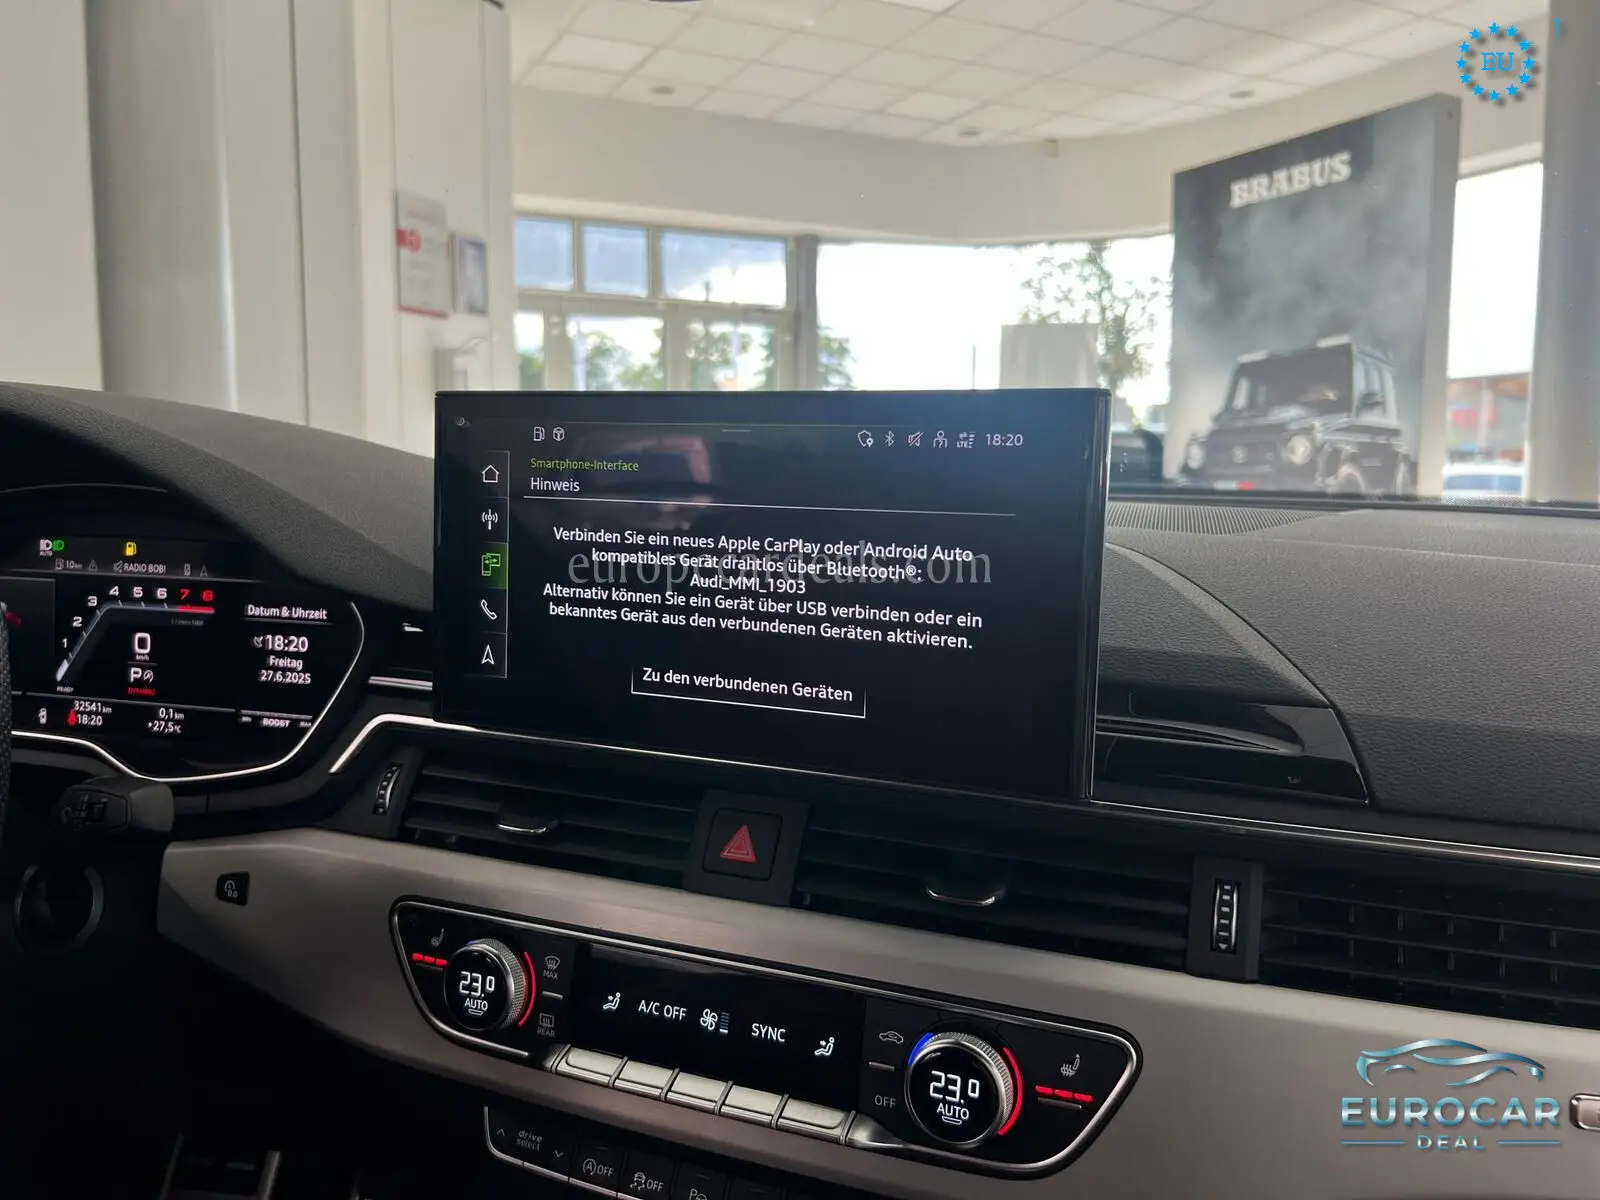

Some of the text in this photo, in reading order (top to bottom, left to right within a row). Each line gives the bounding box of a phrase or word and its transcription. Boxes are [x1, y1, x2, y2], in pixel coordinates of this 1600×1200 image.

[1229, 150, 1352, 208] BRABUS
[985, 433, 1023, 447] 18:20
[530, 457, 639, 472] Smartphone-Interface
[530, 477, 580, 492] Hinweis
[553, 526, 973, 561] Verbinden Sie ein neues Apple CarPlay oder Android Auto
[124, 563, 147, 573] RADIO
[592, 548, 676, 566] kompatibles
[680, 553, 719, 568] Gerät
[722, 556, 784, 572] drahtlos
[788, 559, 823, 574] über
[690, 574, 806, 594] Audi_MMI_1903
[247, 604, 328, 620] Datum & Uhrzeit
[543, 583, 982, 628] Alternativ können Sie ein Gerät über USB verbinden oder ein
[62, 638, 68, 648] 1
[72, 617, 82, 627] 2
[88, 596, 98, 606] 3
[109, 586, 119, 596] 4
[133, 586, 143, 598] 5
[157, 588, 167, 599] 6
[179, 589, 190, 599] 7
[549, 601, 973, 649] bekanntes Gerät aus den verbundenen Geräten aktivieren.
[135, 632, 150, 654] 0
[265, 634, 309, 653] 18:20
[269, 655, 303, 671] Freitag
[130, 667, 142, 682] P
[260, 670, 312, 684] 27.6.2025
[642, 667, 853, 702] Zu den verbundenen Geräten
[73, 700, 102, 712] 32541
[77, 713, 103, 726] 18:20
[262, 718, 291, 728] BOOST
[543, 970, 558, 980] MAX
[464, 998, 488, 1011] AUTO
[638, 999, 687, 1021] A/C OFF
[537, 1027, 555, 1038] REAR
[752, 1023, 786, 1042] SYNC
[874, 1095, 896, 1109] OFF
[936, 1102, 969, 1121] AUTO
[518, 1129, 543, 1142] drive
[515, 1138, 541, 1151] select
[597, 1164, 614, 1178] OFF
[646, 1179, 664, 1193] OFF
